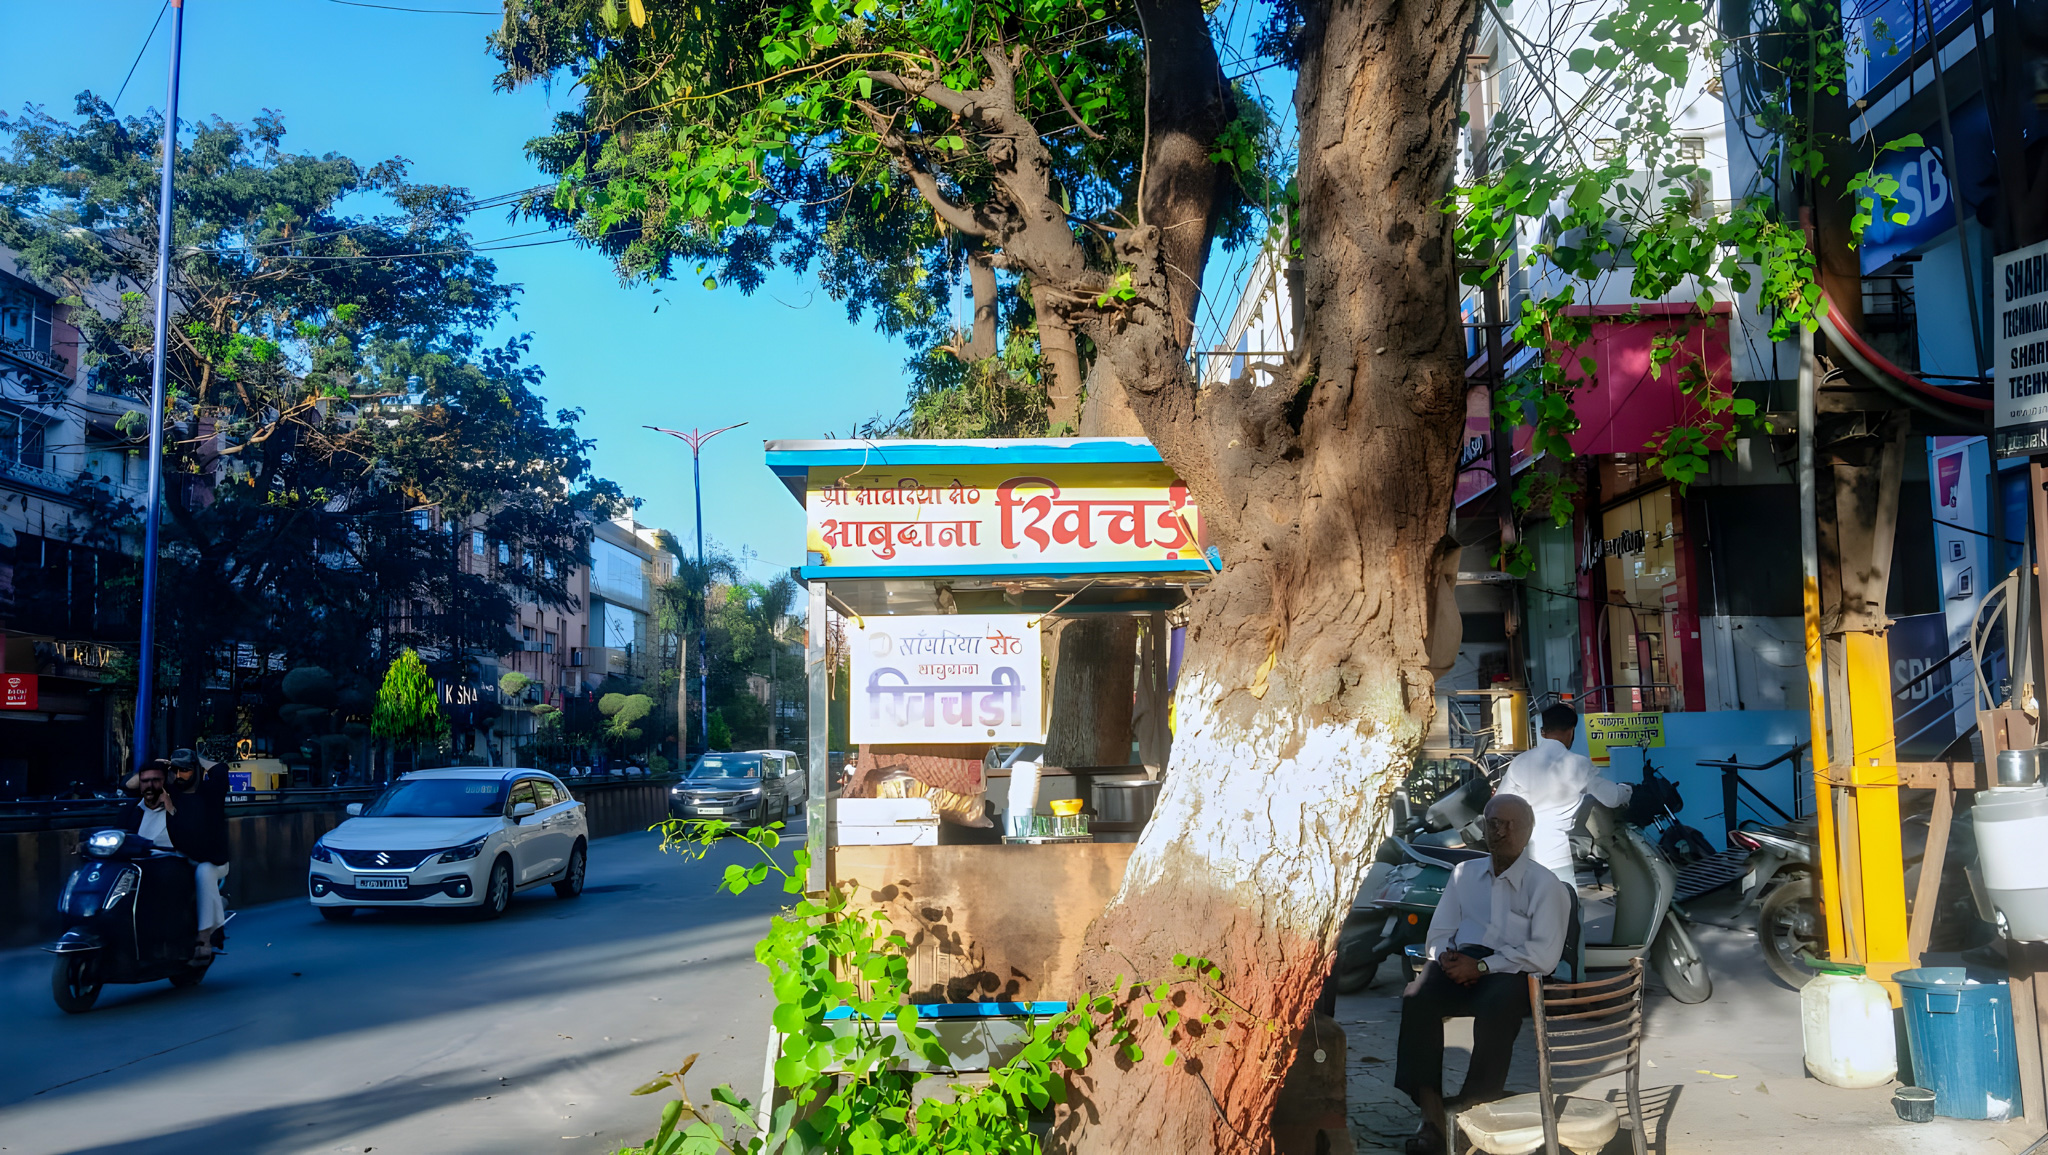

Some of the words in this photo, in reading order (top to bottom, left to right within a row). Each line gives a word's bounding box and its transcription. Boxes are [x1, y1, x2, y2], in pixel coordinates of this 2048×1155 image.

[1900, 146, 1954, 226] SB
[821, 519, 983, 560] साबुदाना
[986, 629, 1023, 655] सेठ
[865, 666, 1026, 737] खिचड़ी
